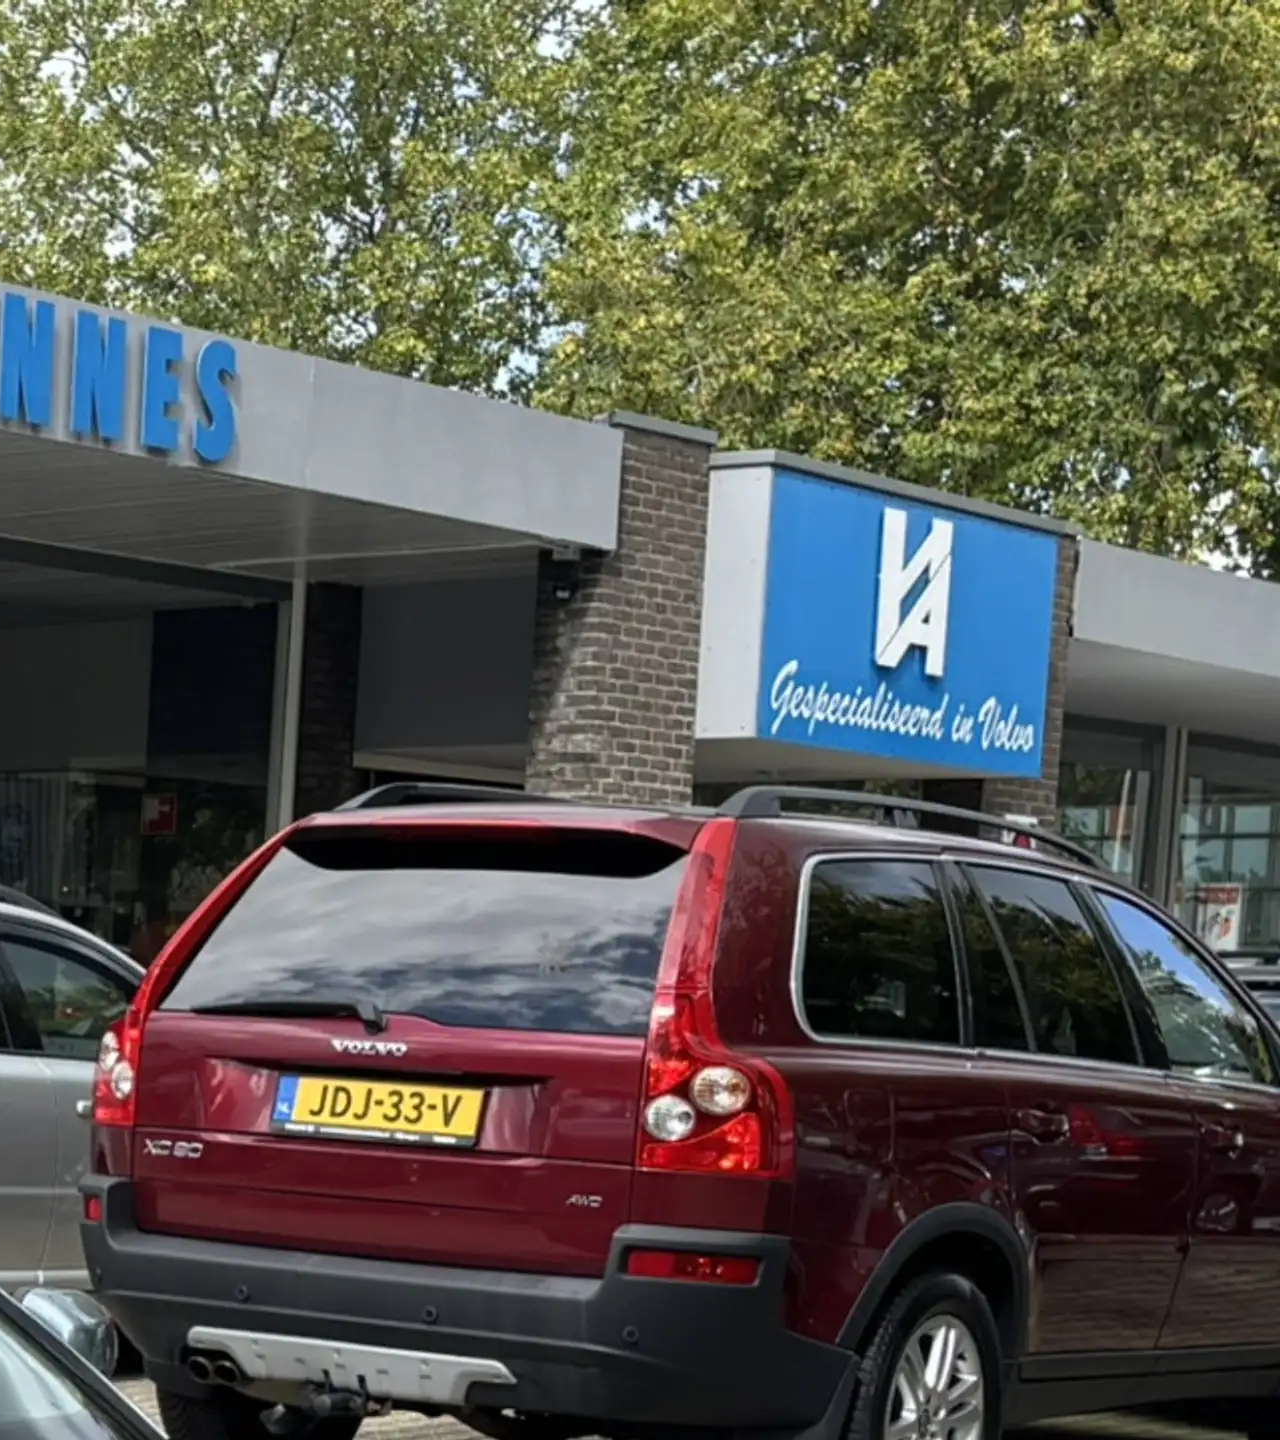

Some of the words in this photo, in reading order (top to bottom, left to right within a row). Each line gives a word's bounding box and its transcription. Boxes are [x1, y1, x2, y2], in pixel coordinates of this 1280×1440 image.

[770, 659, 950, 741] Gespecialiseerd
[951, 703, 975, 744] in
[978, 696, 1035, 753] Volvo
[330, 1039, 408, 1057] VOLVO
[308, 1084, 463, 1128] JDJ-33-V
